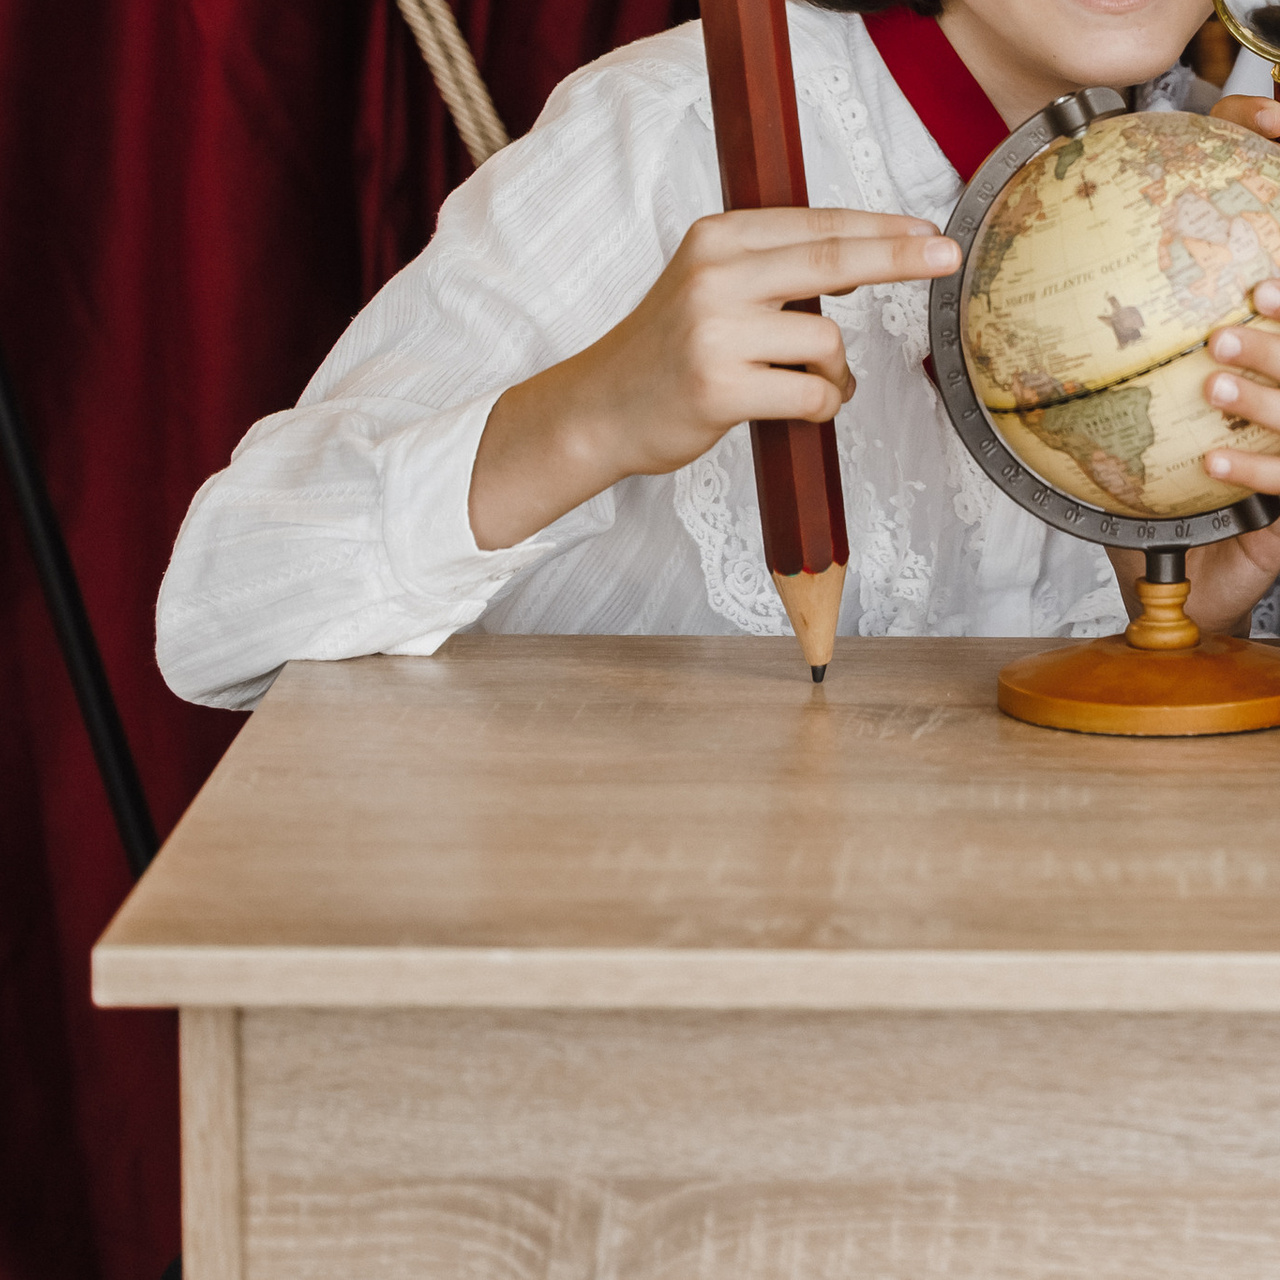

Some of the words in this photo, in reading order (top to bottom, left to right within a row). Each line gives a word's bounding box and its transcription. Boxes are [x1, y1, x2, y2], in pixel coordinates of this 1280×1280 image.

[1003, 152, 1018, 169] 70
[1040, 271, 1095, 298] ATLANTIC
[1099, 252, 1140, 275] OCEAN
[939, 291, 955, 311] 30
[947, 370, 963, 388] 10
[980, 439, 998, 458] 10
[1165, 453, 1206, 473] SOUTH
[1100, 519, 1120, 536] 50
[1174, 523, 1193, 538] 70
